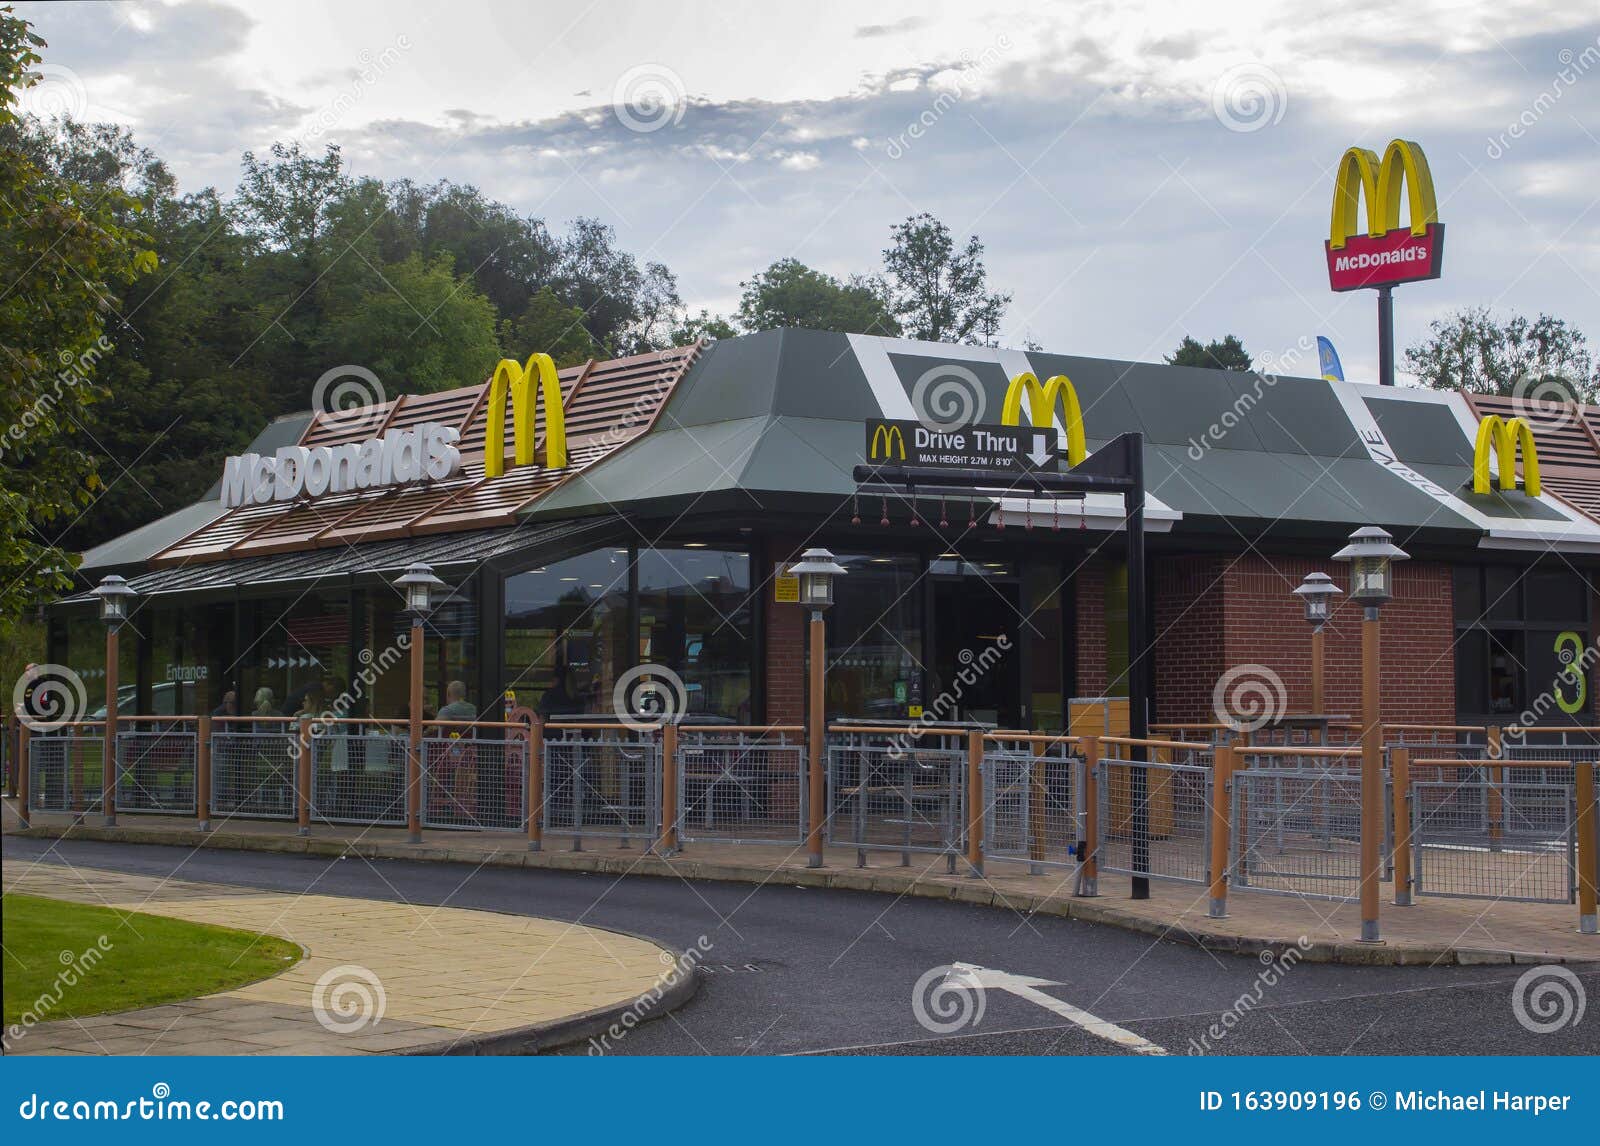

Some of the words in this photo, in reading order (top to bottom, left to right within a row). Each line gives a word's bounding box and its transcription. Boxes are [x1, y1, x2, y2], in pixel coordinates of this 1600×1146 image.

[1335, 246, 1427, 272] McDonald's
[914, 427, 966, 450] Drive
[972, 430, 1017, 453] Thru
[220, 421, 461, 508] McDonald's
[919, 453, 937, 463] MAX
[939, 454, 967, 464] HEIGHT
[970, 457, 988, 465] 2.7M
[166, 664, 208, 680] Entrance
[1553, 631, 1586, 714] 3
